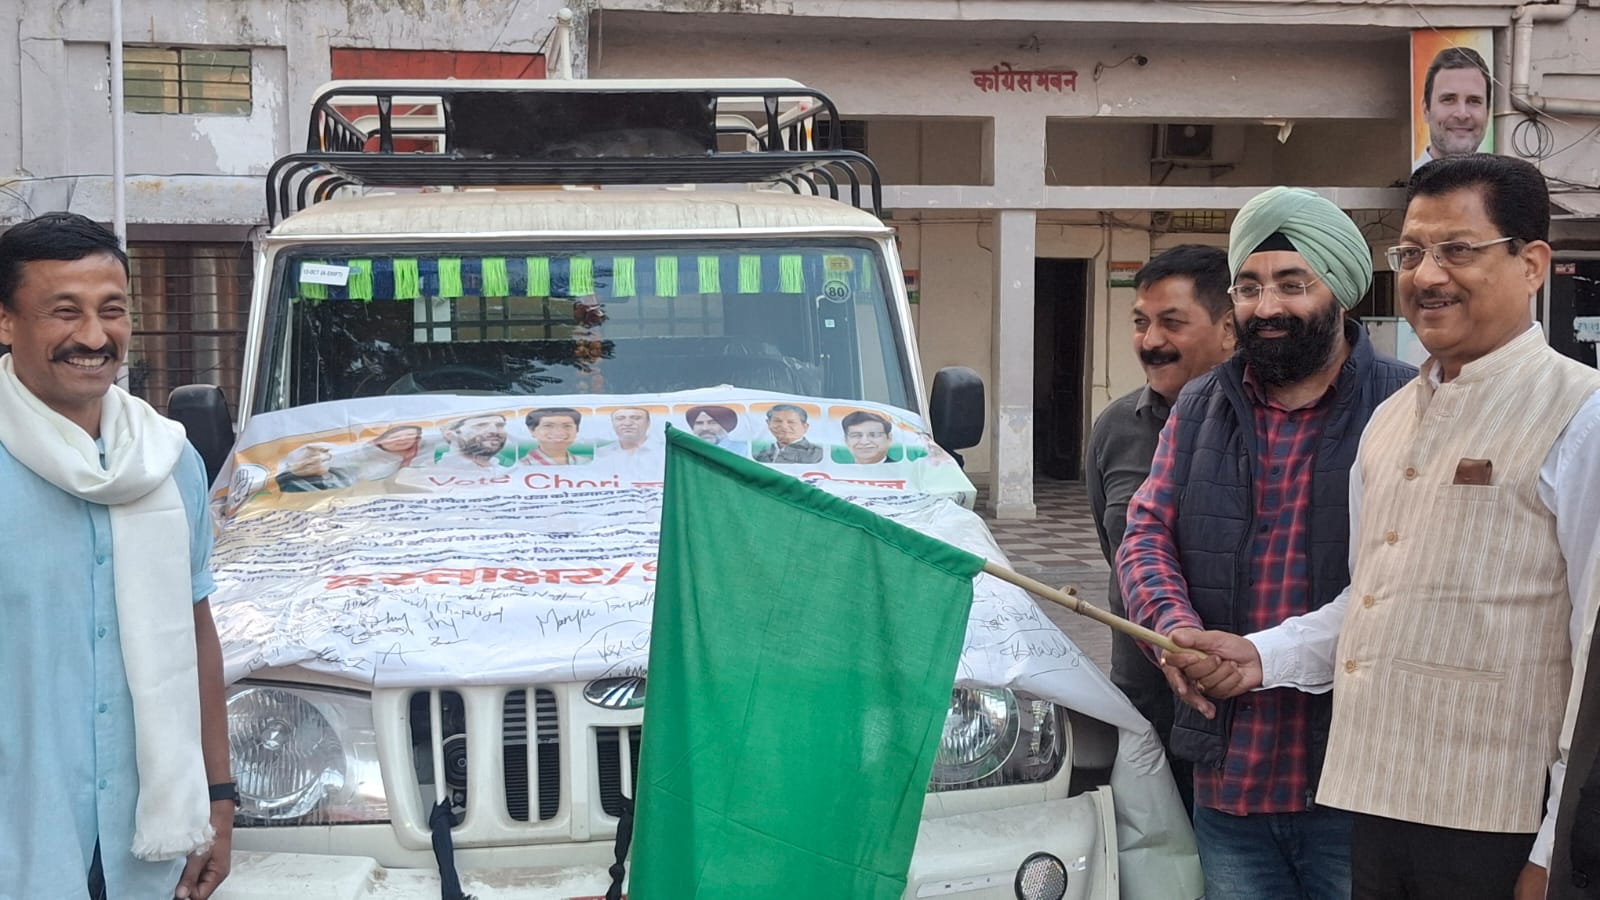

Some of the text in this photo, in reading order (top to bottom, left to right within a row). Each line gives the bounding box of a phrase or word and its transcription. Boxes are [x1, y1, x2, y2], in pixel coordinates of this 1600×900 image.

[971, 62, 1032, 92] कांग्रेस
[828, 287, 845, 298] 80
[428, 474, 511, 486] Vote
[524, 473, 619, 490] Chori
